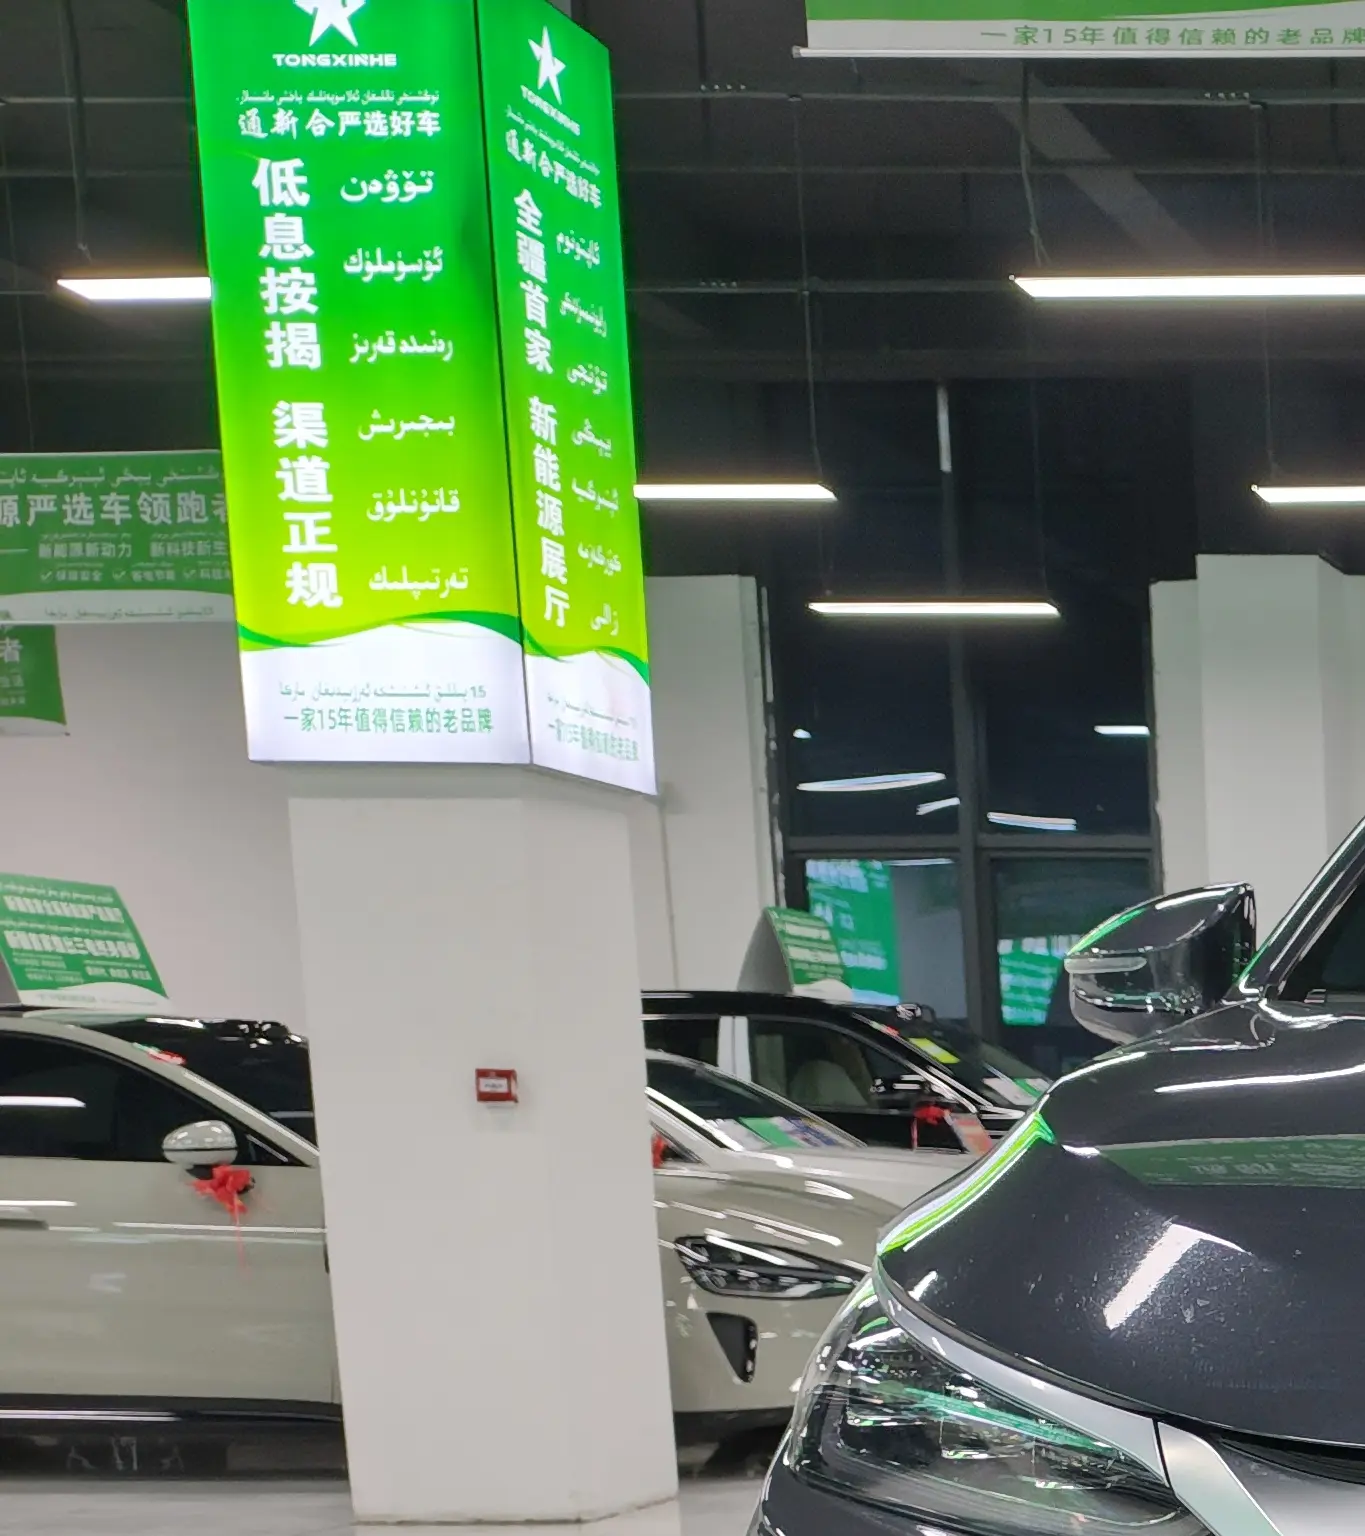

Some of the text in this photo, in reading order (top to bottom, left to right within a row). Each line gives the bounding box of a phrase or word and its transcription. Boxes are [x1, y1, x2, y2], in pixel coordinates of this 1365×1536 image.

[272, 53, 397, 67] TONGXINHE
[238, 107, 441, 139] 通新合严选好车
[340, 169, 434, 202] تۆۋەن
[514, 188, 553, 374] 全疆首家
[252, 158, 343, 608] 低息按揭 渠道正规
[367, 487, 460, 521] قانۇنلۇق
[528, 395, 570, 628] 新能源展厅
[470, 685, 487, 698] 15
[284, 708, 493, 733] 一家15年值得信赖的老品牌
